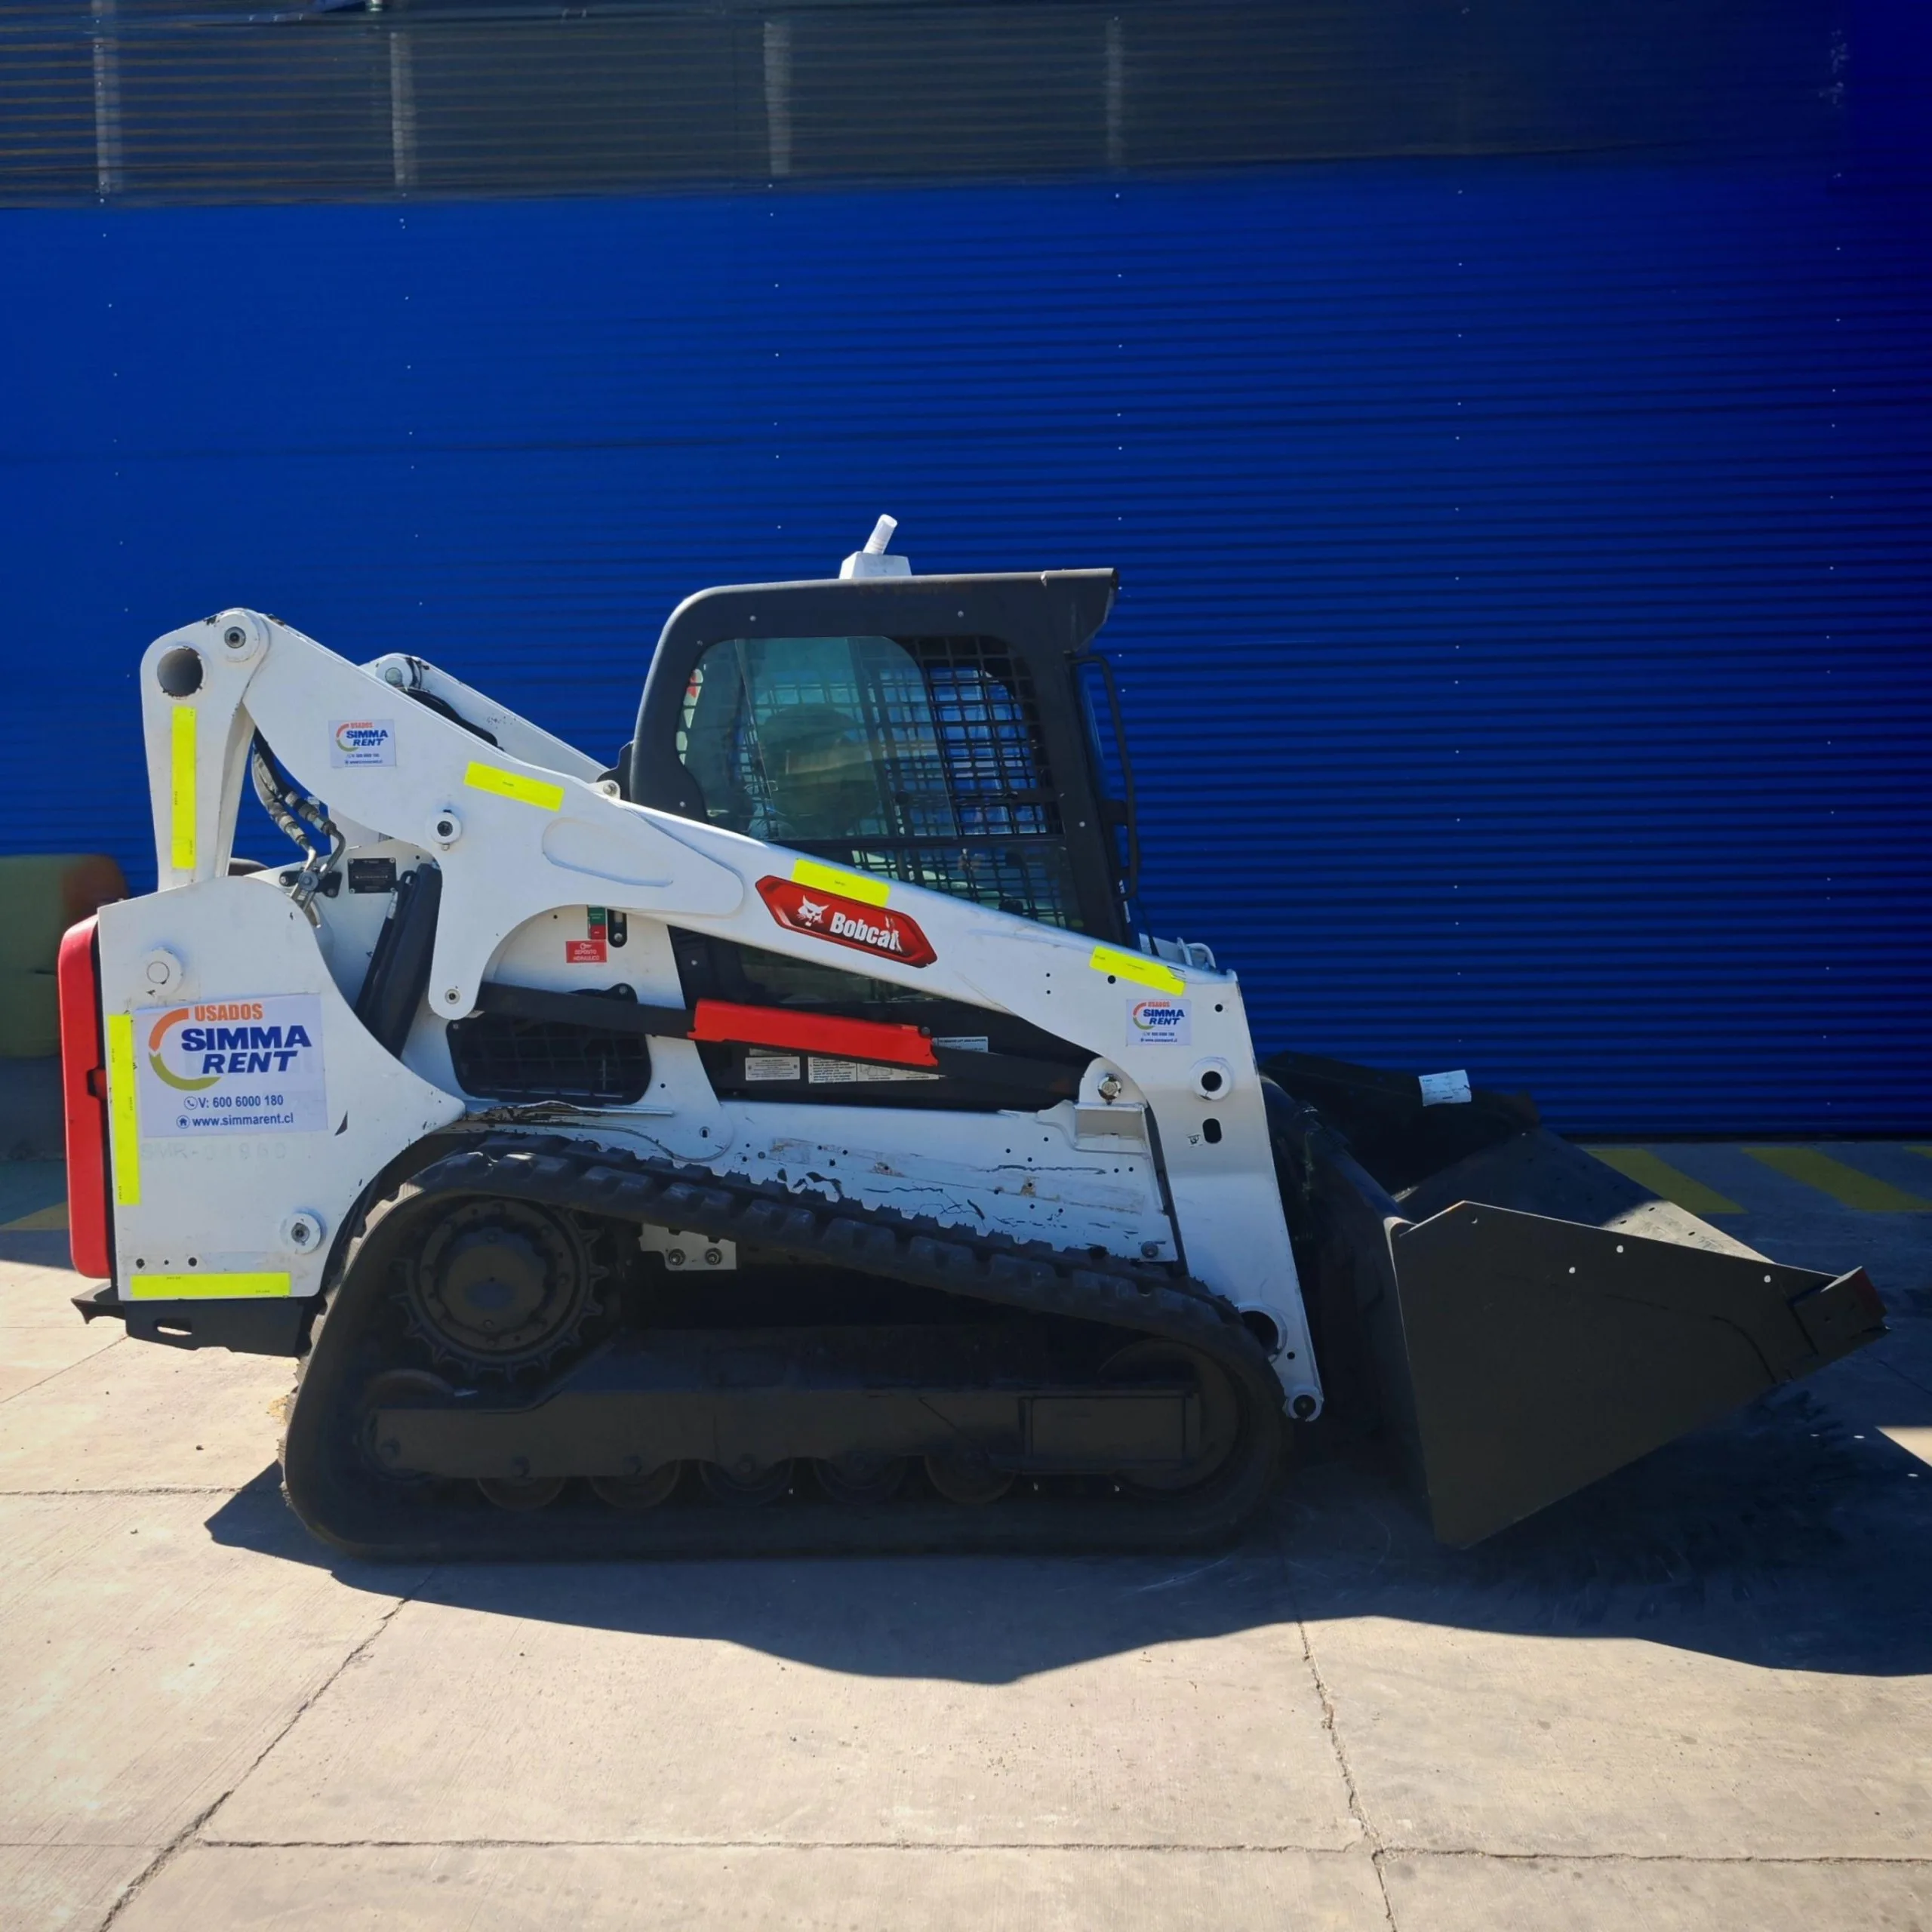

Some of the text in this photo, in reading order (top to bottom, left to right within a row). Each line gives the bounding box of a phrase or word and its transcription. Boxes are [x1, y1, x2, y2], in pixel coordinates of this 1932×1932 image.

[346, 730, 388, 739] SIMMA
[353, 738, 384, 746] RENT
[830, 912, 900, 952] Bobcat
[195, 1003, 263, 1022] USADOS
[1143, 1008, 1185, 1017] SIMMA
[181, 1025, 312, 1051] SIMMA
[202, 1050, 298, 1074] RENT
[199, 1094, 284, 1108] V: 600 6000 180
[192, 1112, 294, 1127] www.simmarent.cl
